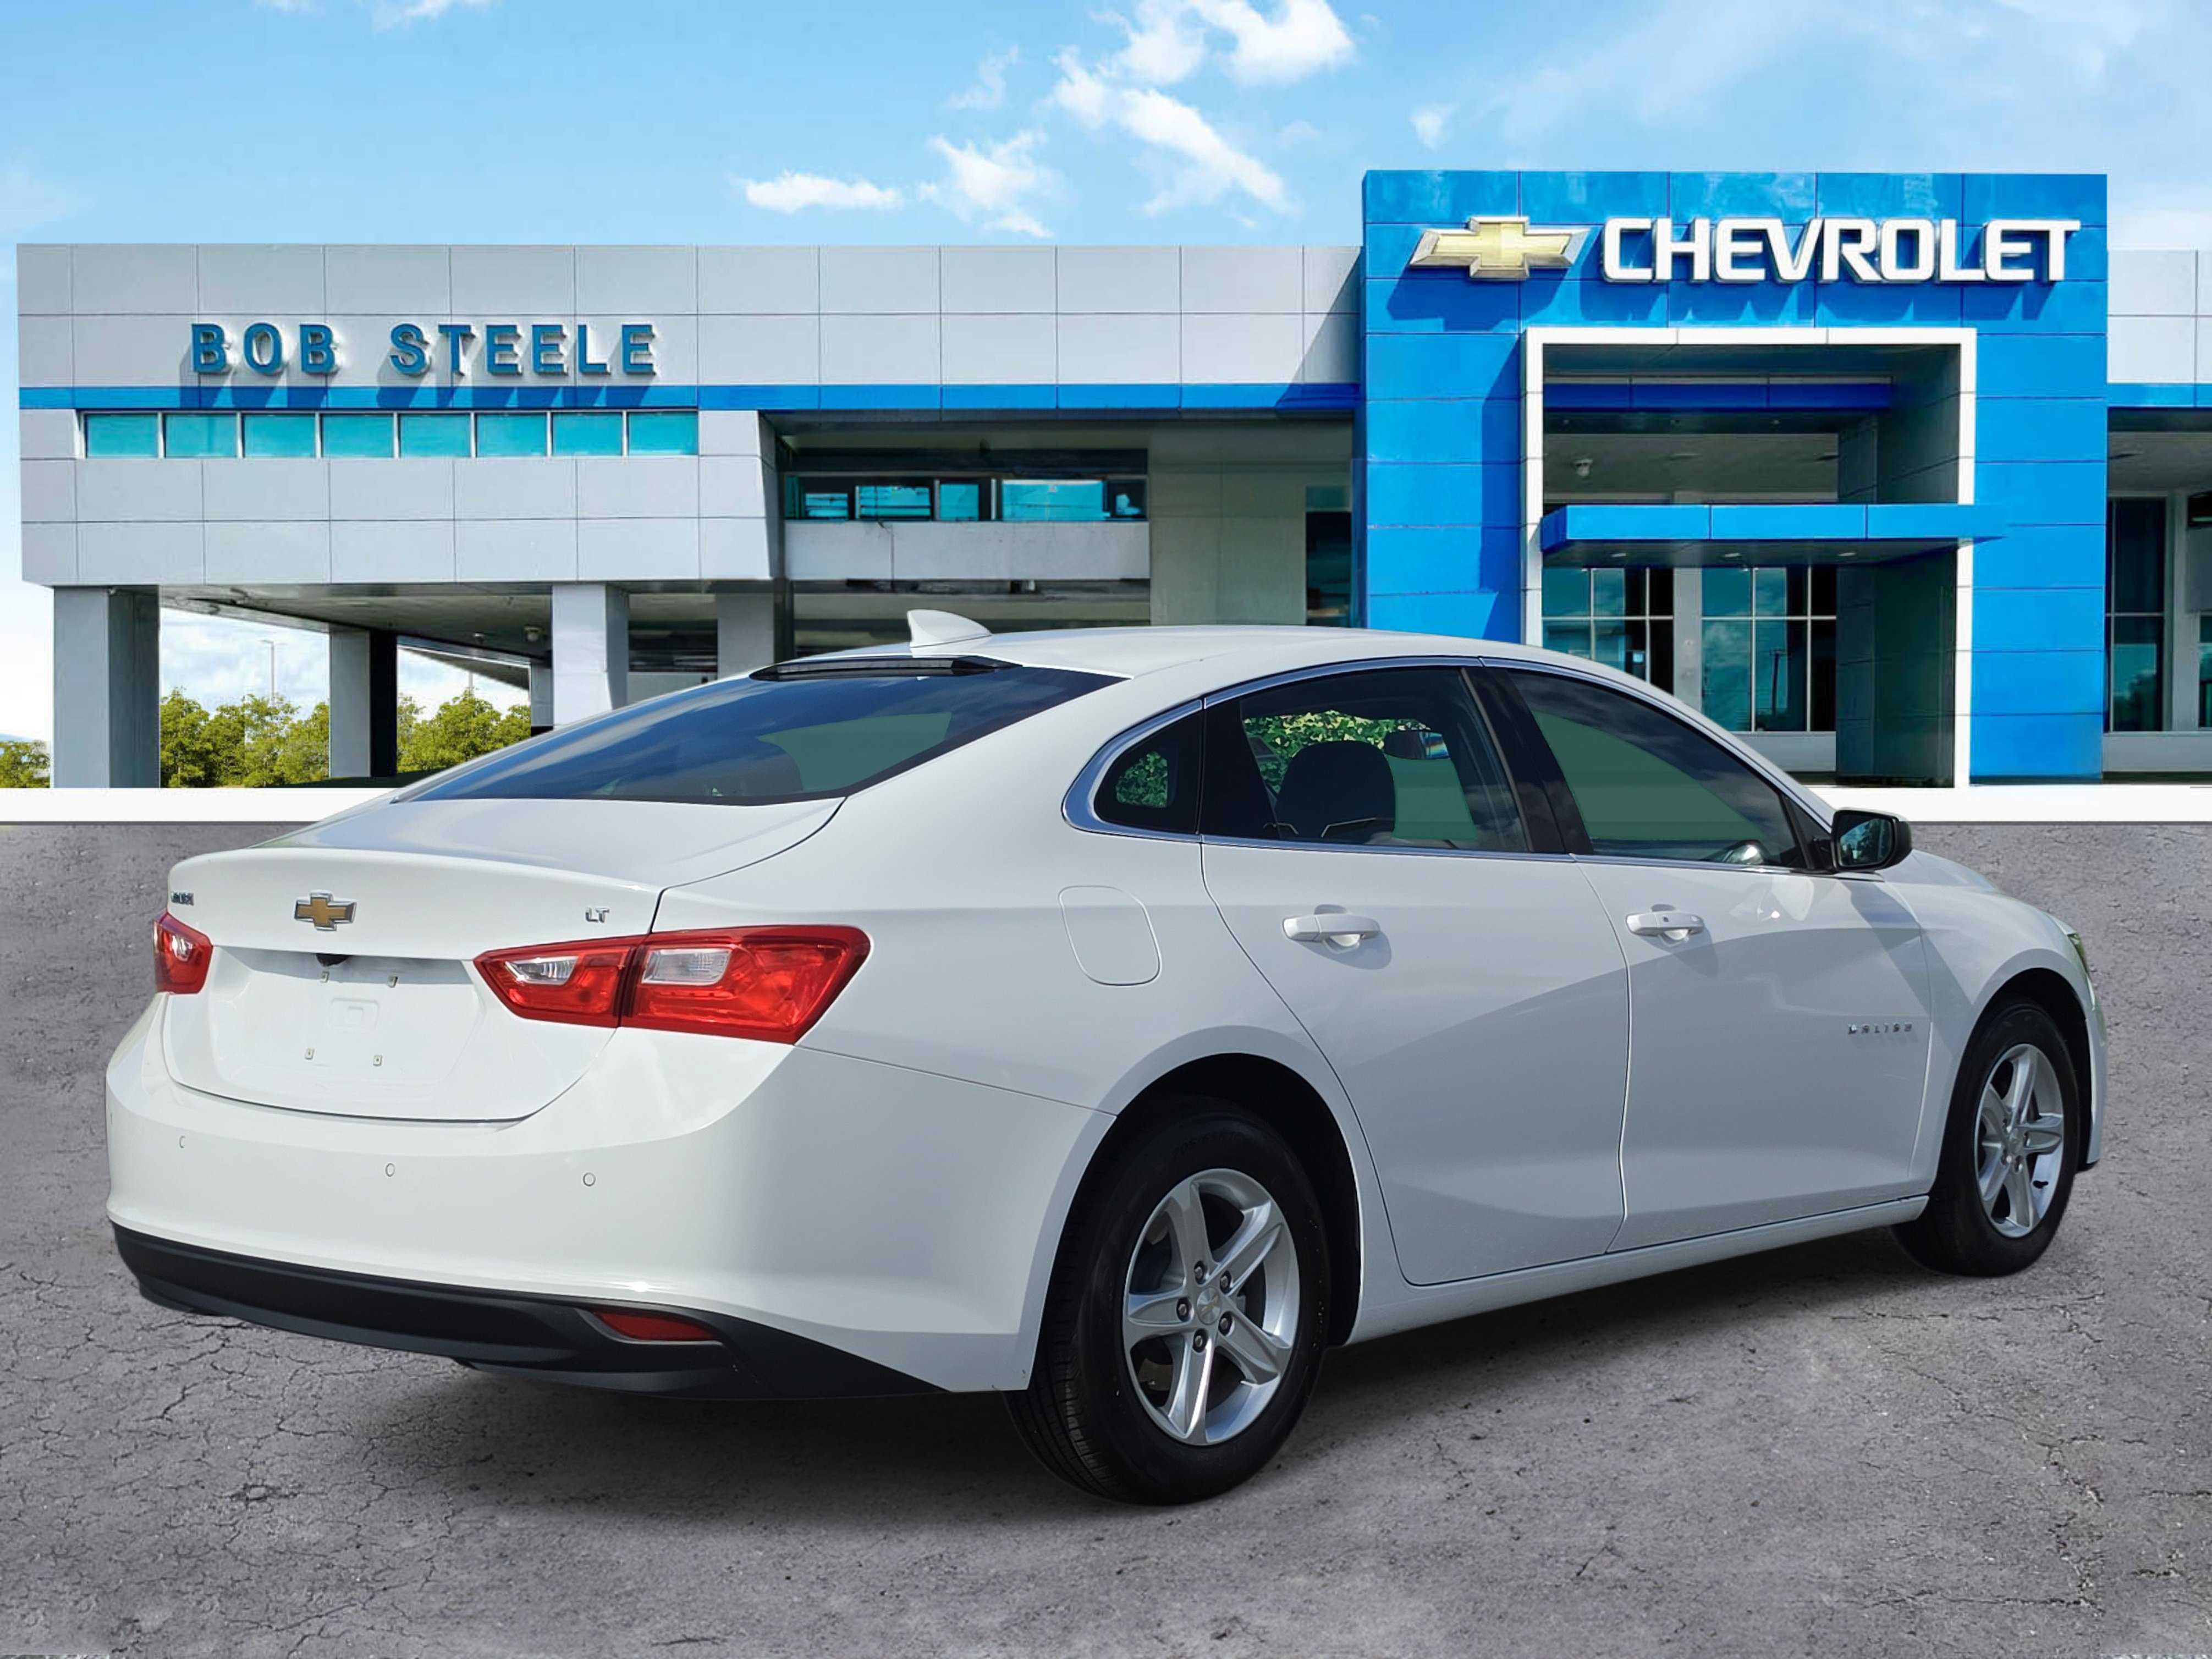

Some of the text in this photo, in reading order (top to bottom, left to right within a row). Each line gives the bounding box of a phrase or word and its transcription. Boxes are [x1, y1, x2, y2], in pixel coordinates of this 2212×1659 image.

[1604, 217, 2081, 282] CHEVROLET
[191, 322, 657, 376] BOB STEELE
[585, 907, 609, 923] LT
